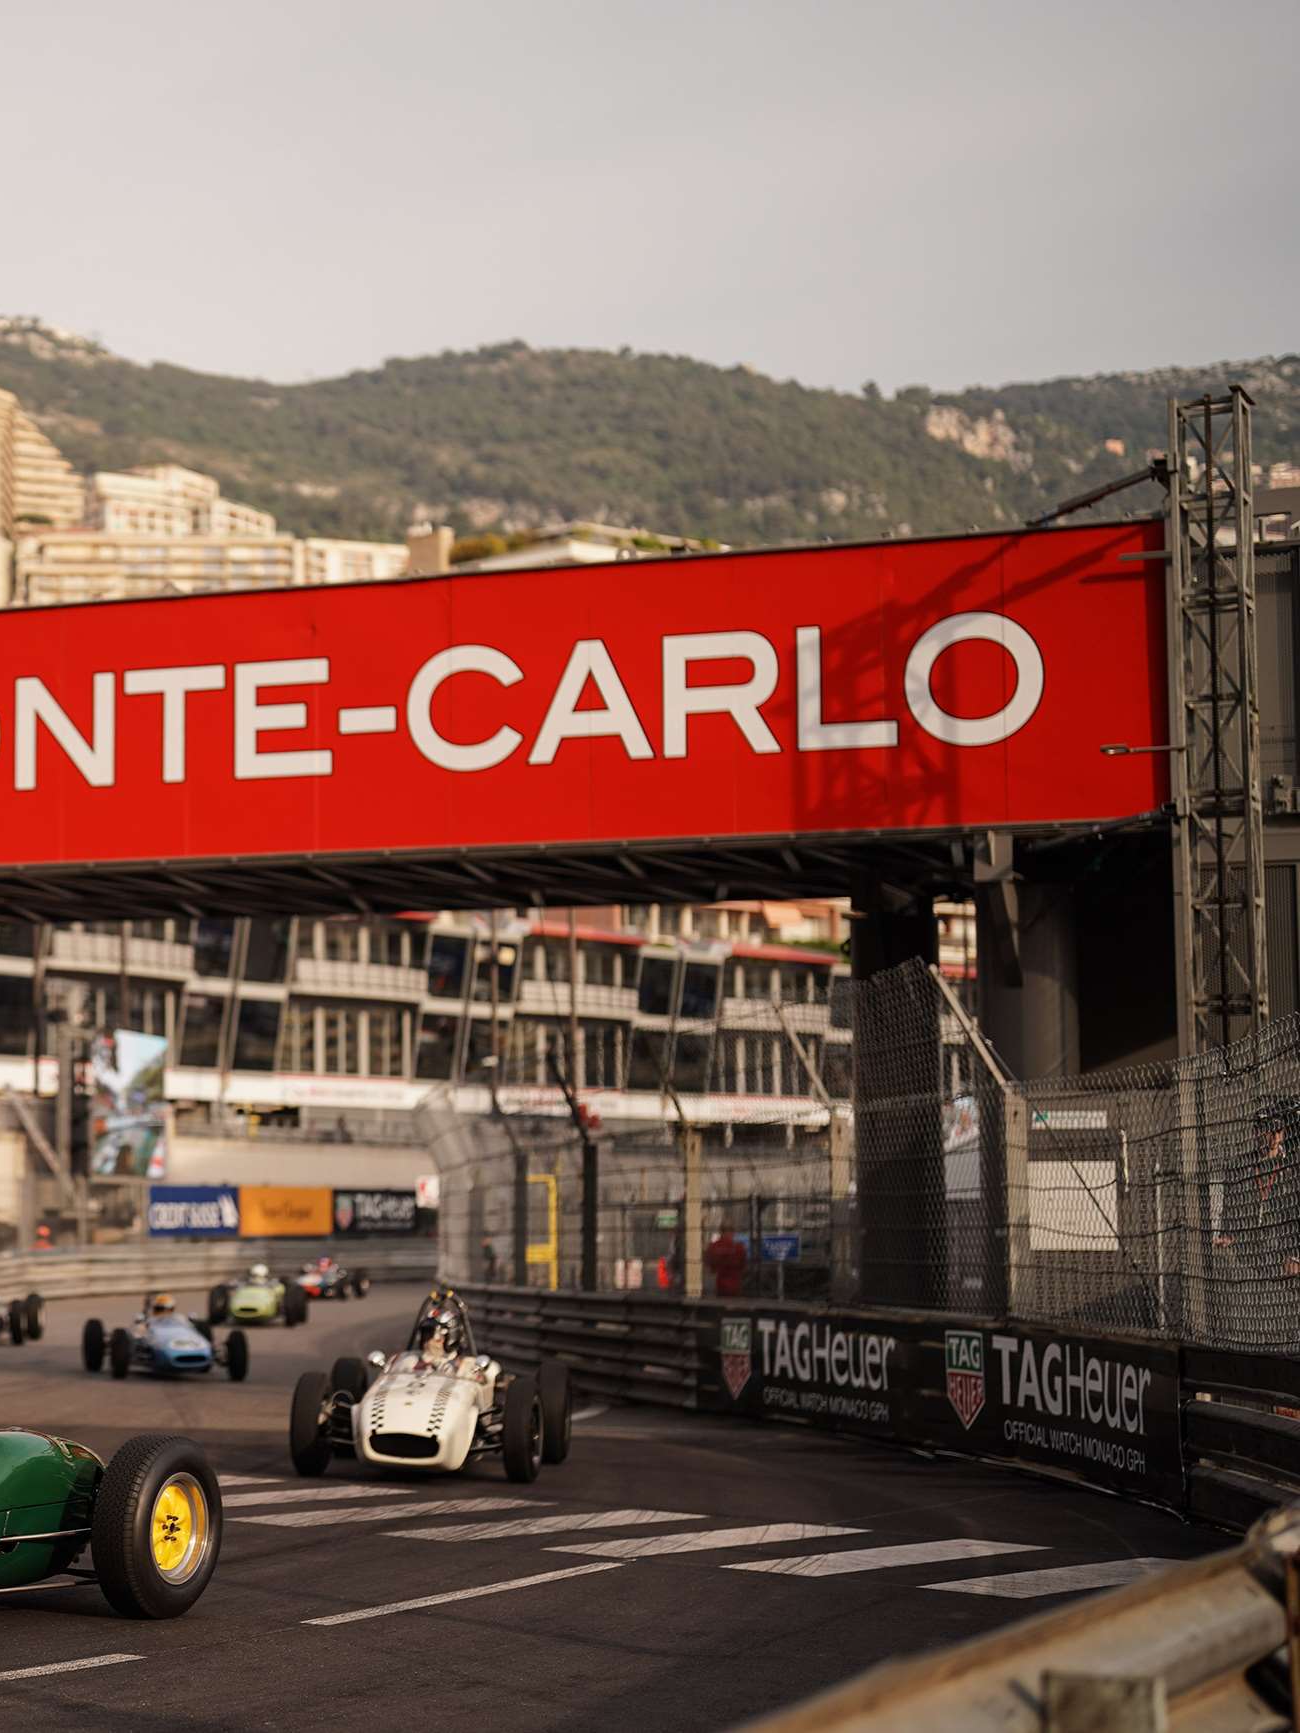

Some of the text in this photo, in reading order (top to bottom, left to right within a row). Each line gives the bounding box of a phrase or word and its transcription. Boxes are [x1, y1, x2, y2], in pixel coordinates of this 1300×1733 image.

[722, 1324, 749, 1349] TAG
[948, 1337, 981, 1368] TAG
[949, 1374, 984, 1424] HEUER
[1003, 1419, 1146, 1475] OFFICIAL WATCH MONACO GPH
